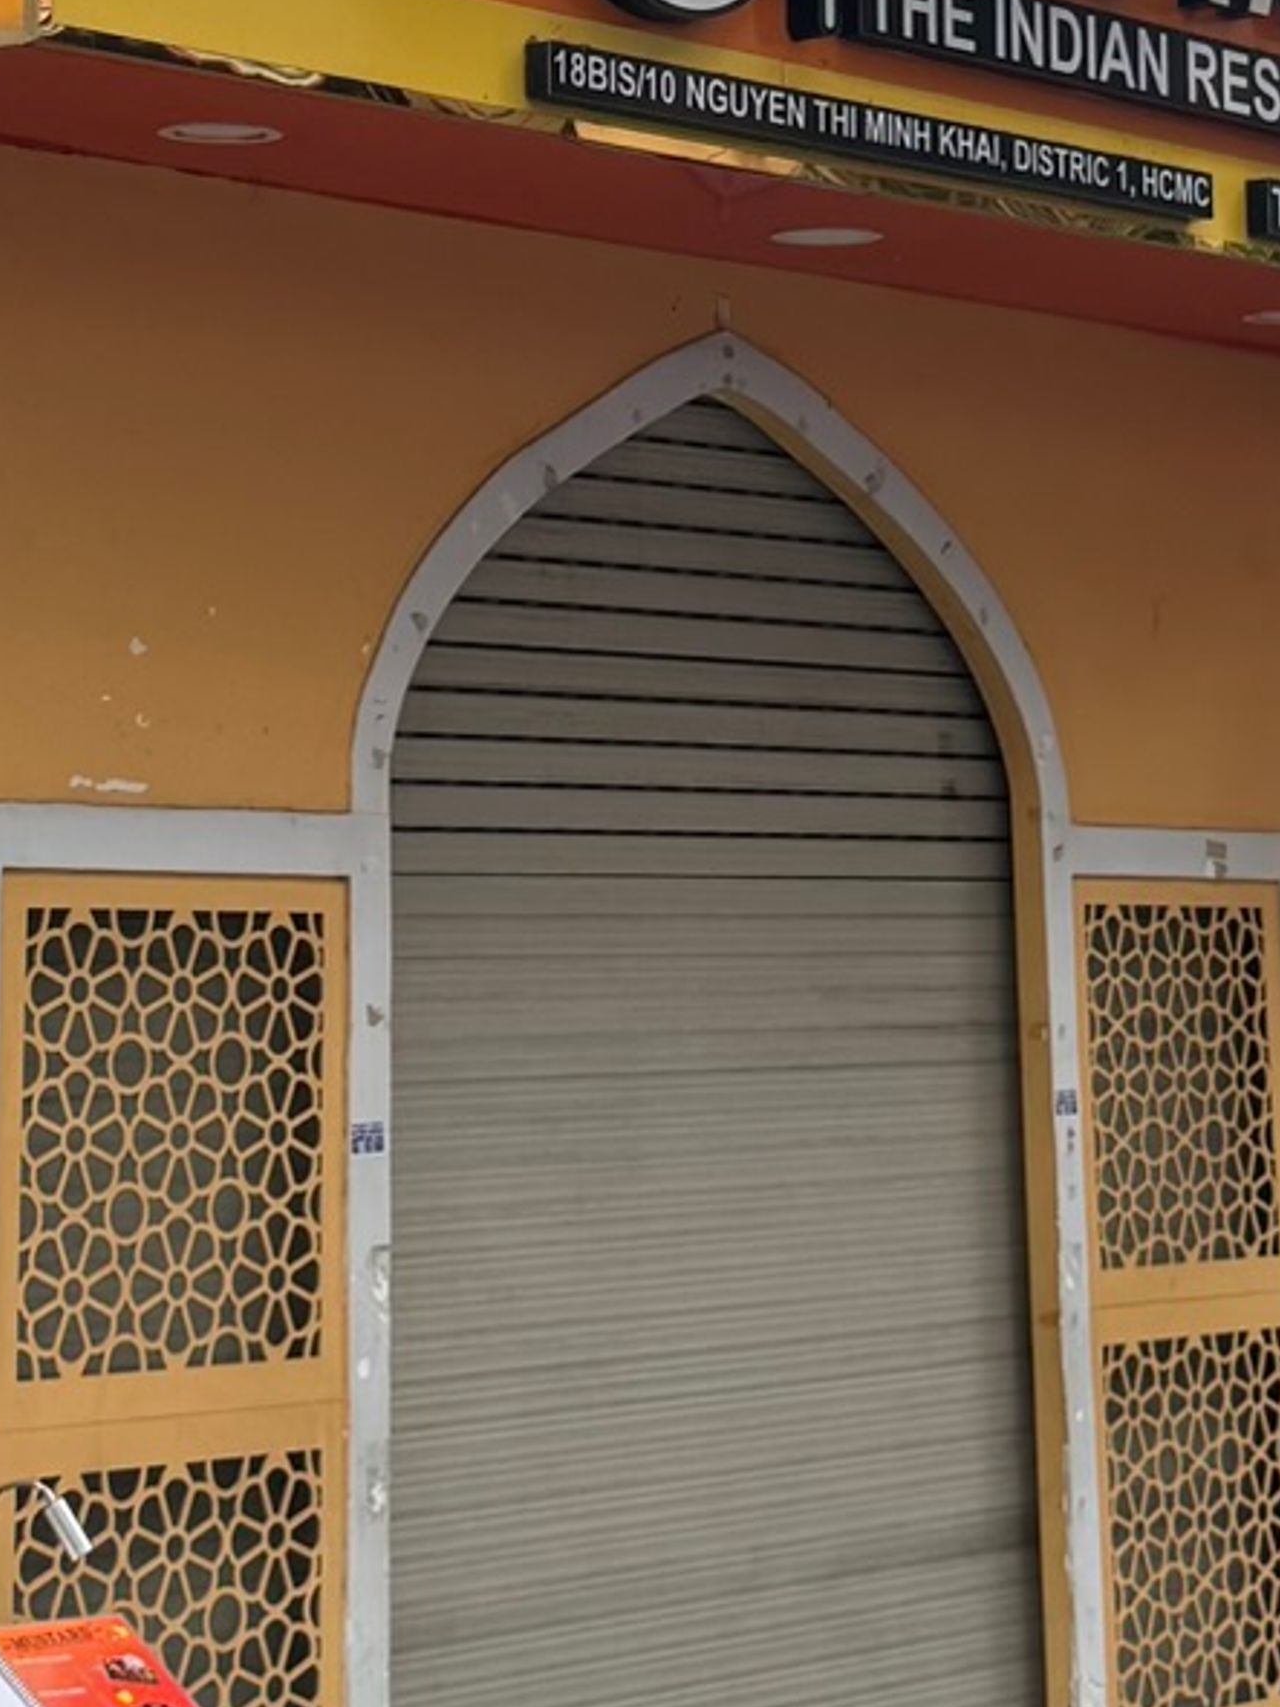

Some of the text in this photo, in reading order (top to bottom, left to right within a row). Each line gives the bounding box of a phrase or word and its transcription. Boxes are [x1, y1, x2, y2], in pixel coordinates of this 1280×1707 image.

[552, 48, 1211, 208] 18BIS/10 NGUYEN THI MINH KHAI, DISTRIC 1, HCMC
